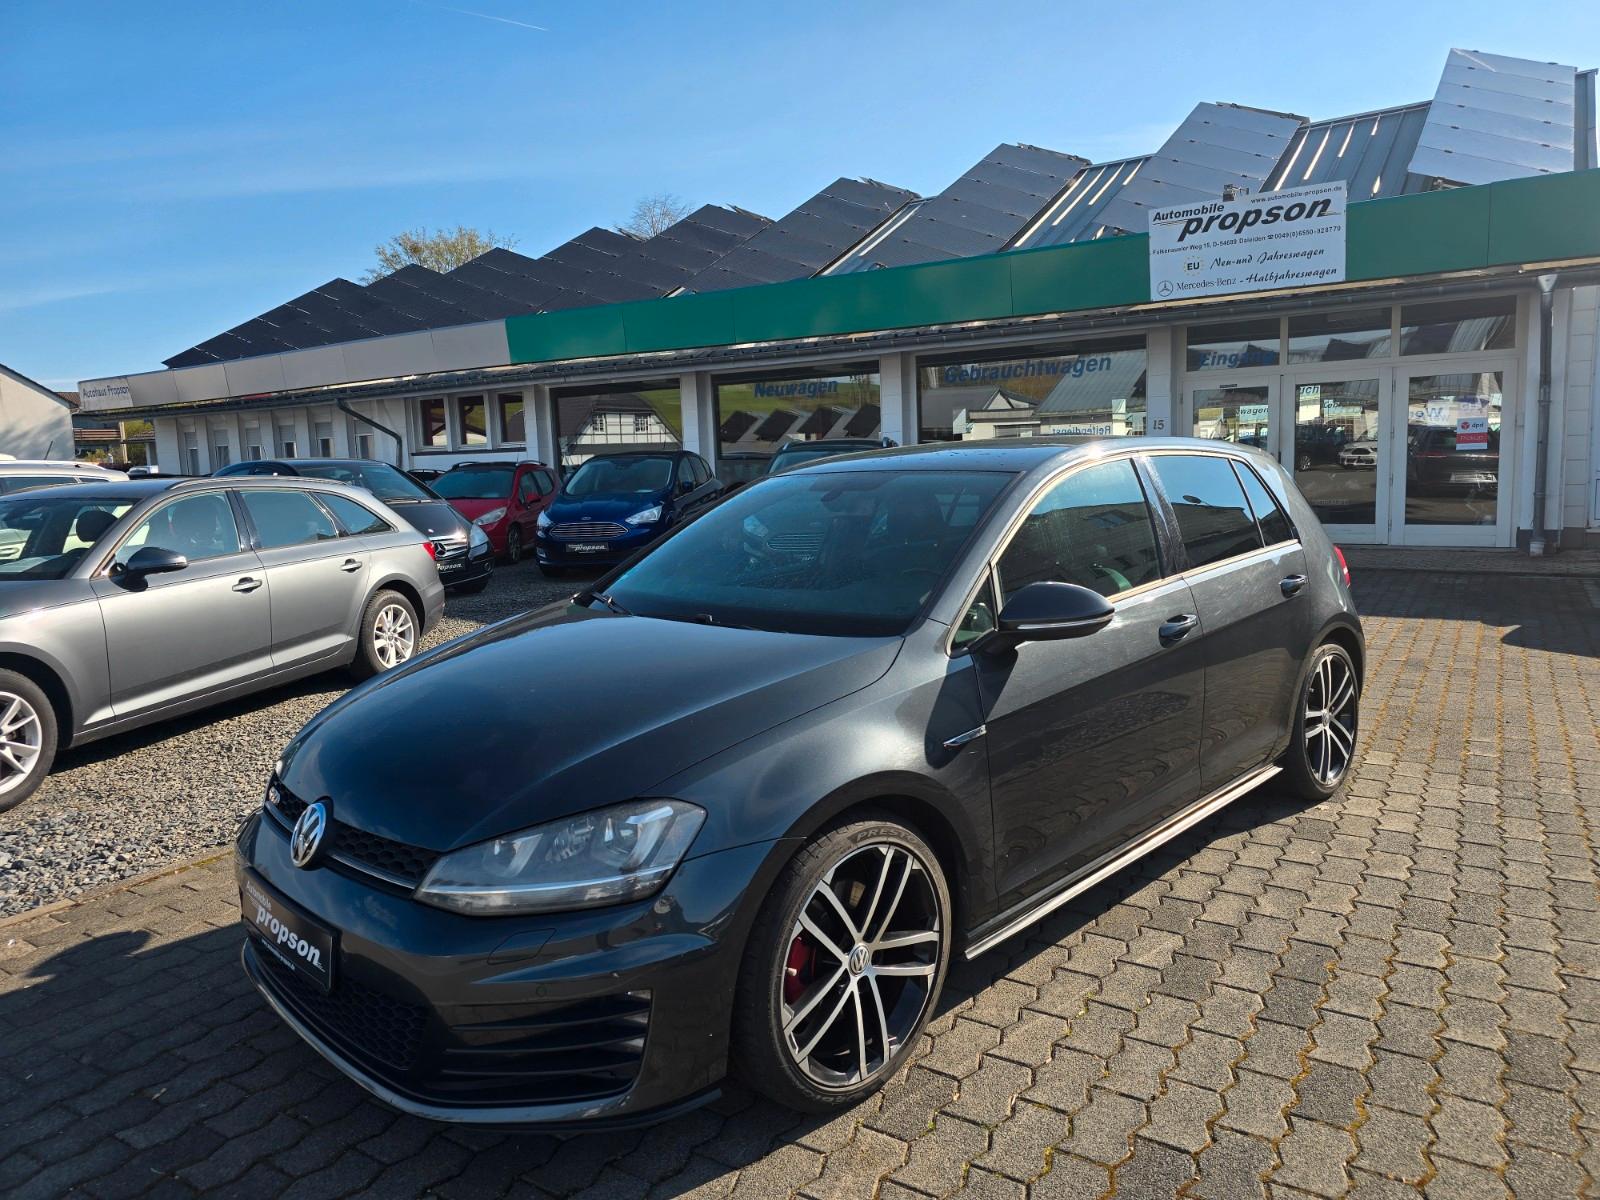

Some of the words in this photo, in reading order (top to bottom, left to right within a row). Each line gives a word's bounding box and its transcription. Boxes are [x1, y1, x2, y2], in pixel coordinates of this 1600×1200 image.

[1250, 185, 1342, 204] www.automobile-propson.de
[1152, 203, 1225, 222] Automobile
[1177, 198, 1332, 242] propson
[1256, 247, 1325, 265] Jahreswagen
[1186, 261, 1200, 271] EU
[1176, 277, 1237, 291] Mercedes-Benz
[943, 355, 1112, 384] Gebrauchtwagen
[754, 380, 839, 400] Neuwagen
[1152, 419, 1165, 430] 15
[255, 904, 321, 967] propson
